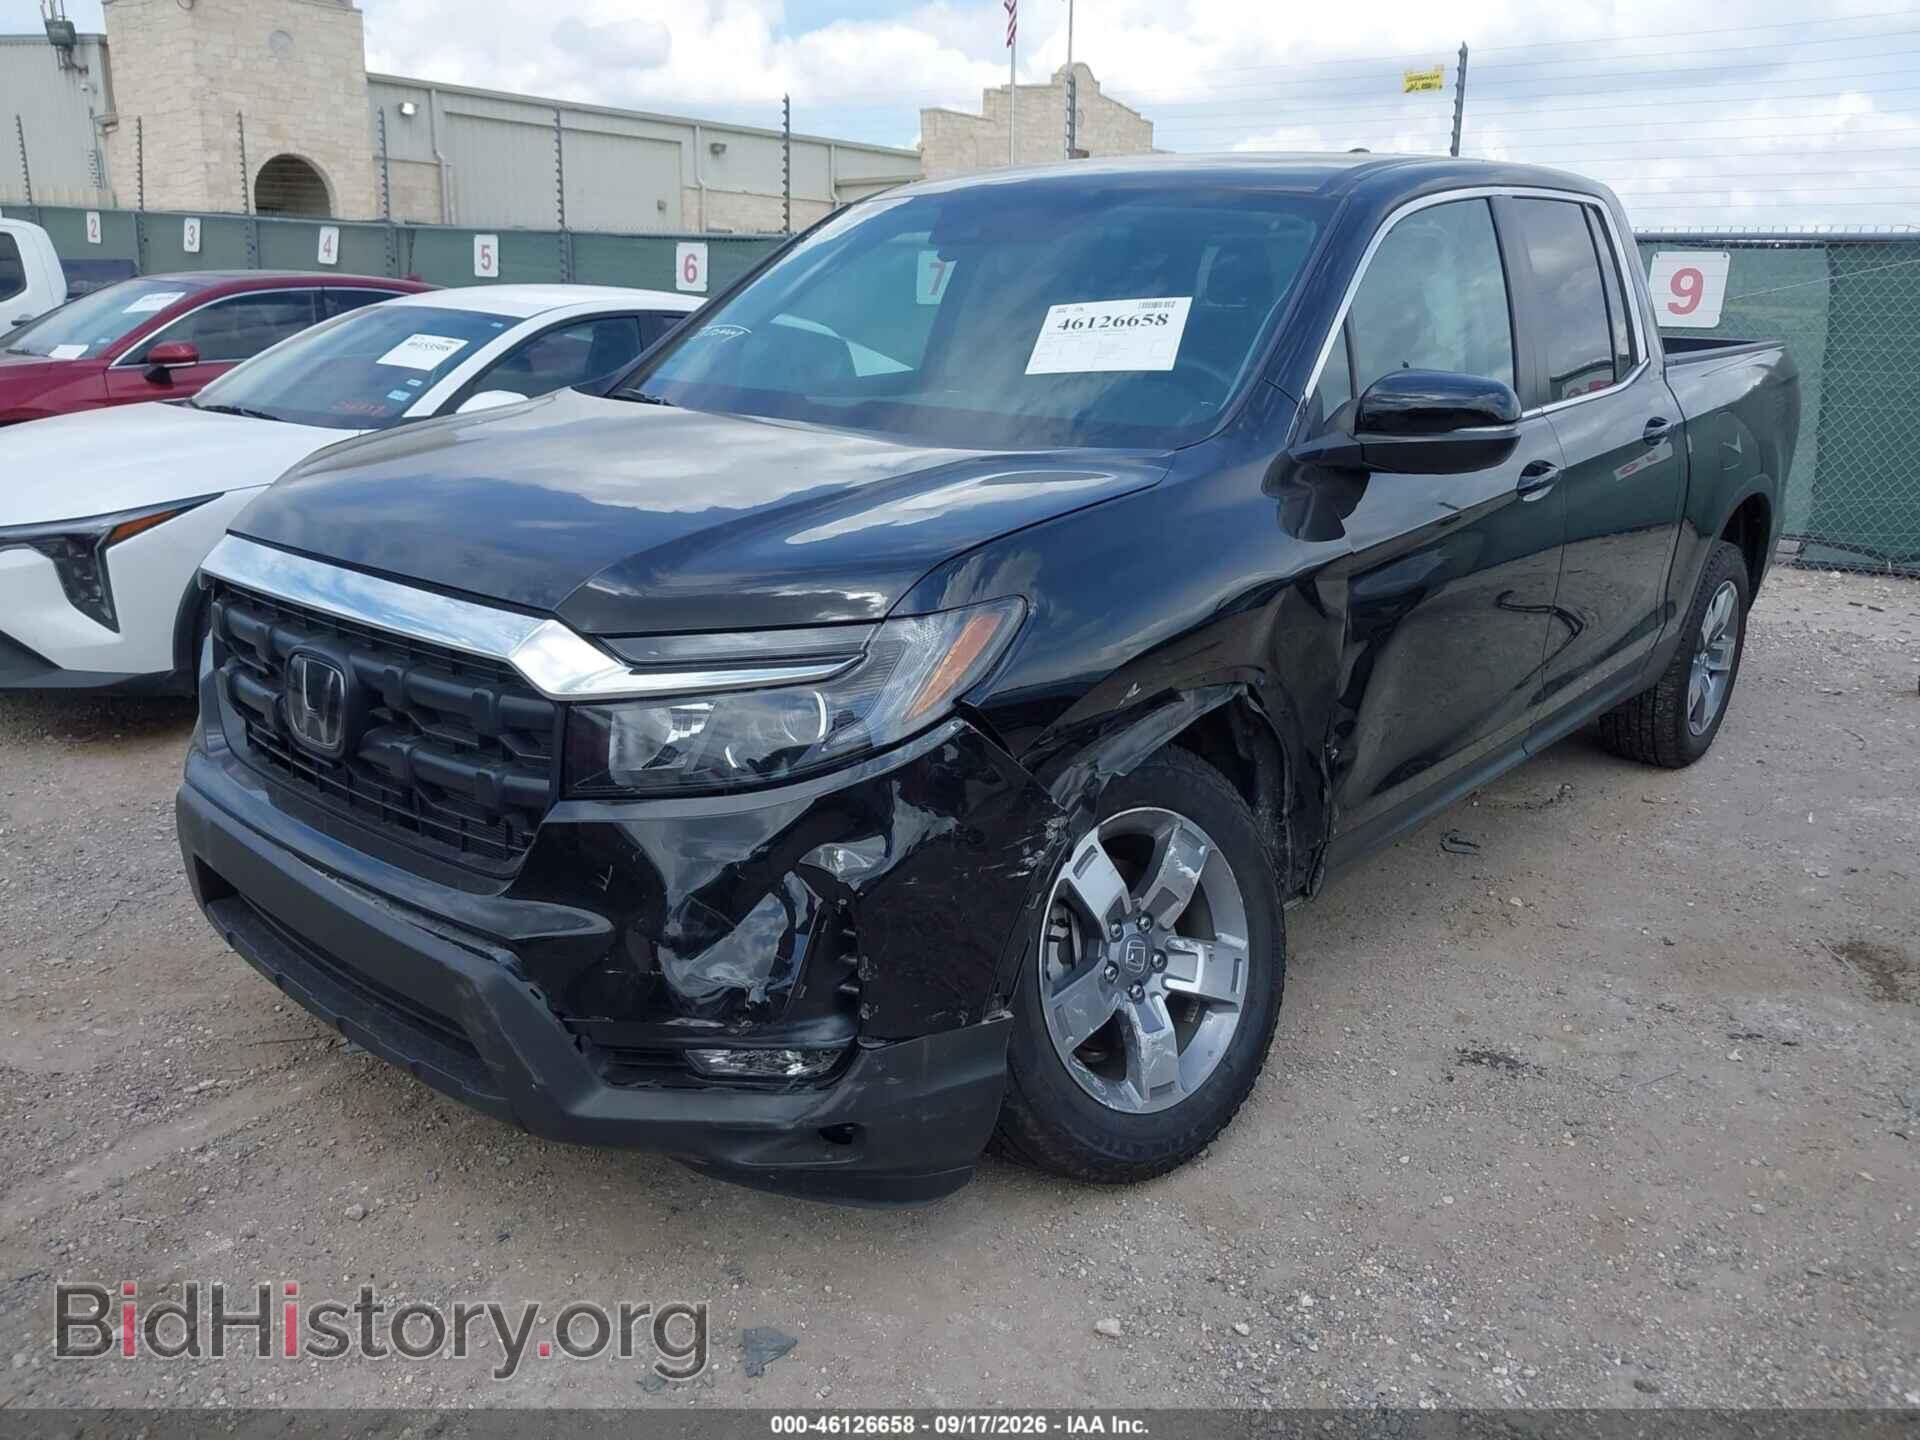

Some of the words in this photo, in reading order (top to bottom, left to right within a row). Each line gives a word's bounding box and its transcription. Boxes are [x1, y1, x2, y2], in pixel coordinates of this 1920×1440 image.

[90, 218, 97, 238] 2
[188, 225, 196, 246] 3
[323, 234, 333, 257] 4
[480, 244, 492, 270] 5
[684, 253, 698, 283] 6
[928, 262, 945, 296] 7
[1667, 267, 1704, 315] 9
[1057, 312, 1169, 331] 46126658
